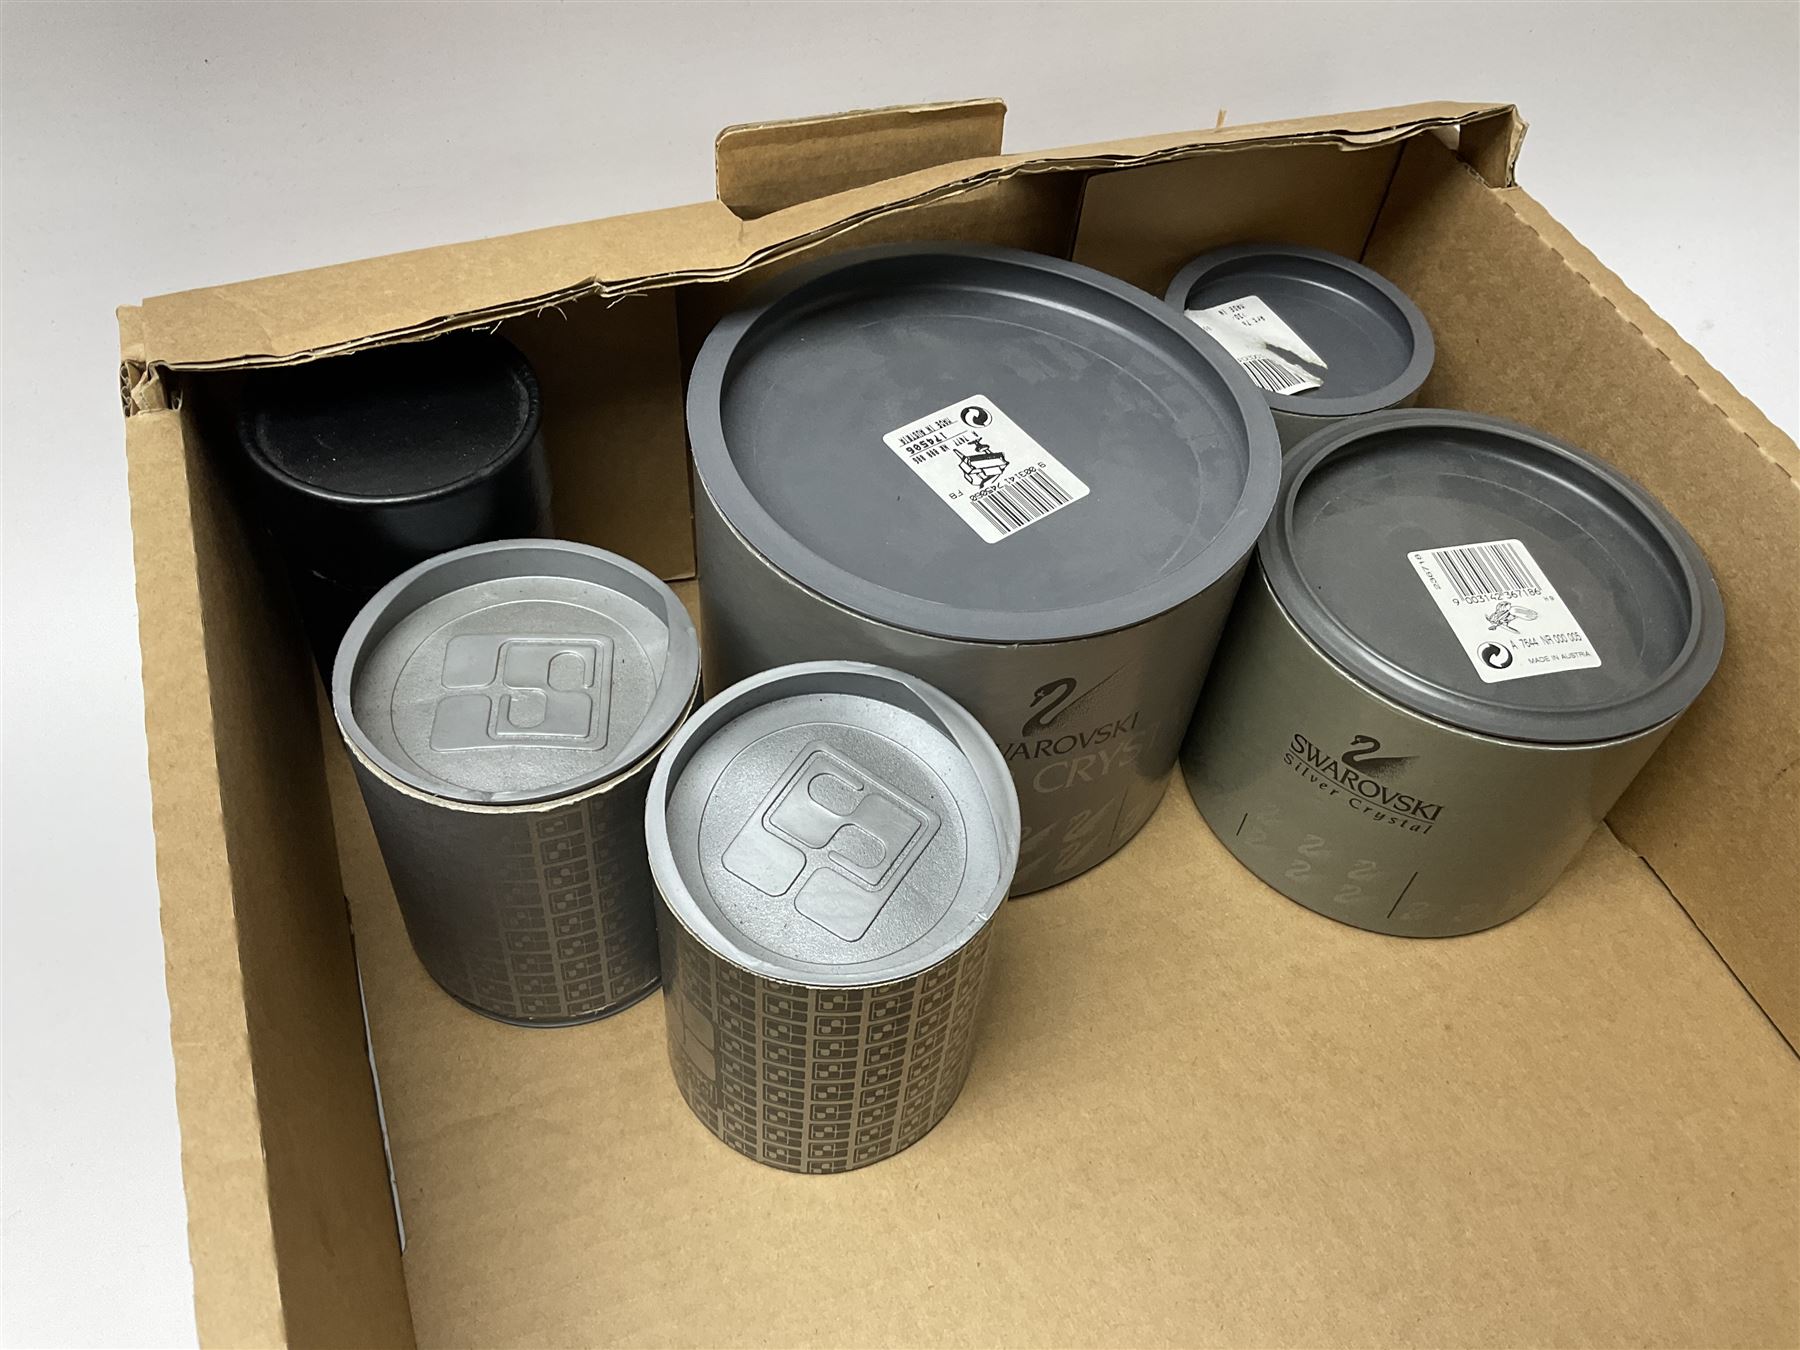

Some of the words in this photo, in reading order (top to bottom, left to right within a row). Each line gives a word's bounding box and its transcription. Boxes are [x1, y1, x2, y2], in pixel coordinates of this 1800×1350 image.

[1452, 598, 1460, 606] 9
[1465, 592, 1503, 604] 003142
[1503, 586, 1542, 599] 367186
[1510, 640, 1518, 649] A
[1539, 635, 1555, 645] NR
[1552, 633, 1568, 644] 000
[1528, 655, 1550, 664] MADE
[1551, 653, 1561, 662] IN
[1561, 650, 1591, 659] AUSTRIA
[1291, 733, 1444, 821] SWAROVSKI
[1284, 752, 1339, 796] Silver
[1349, 798, 1432, 834] Crystal
